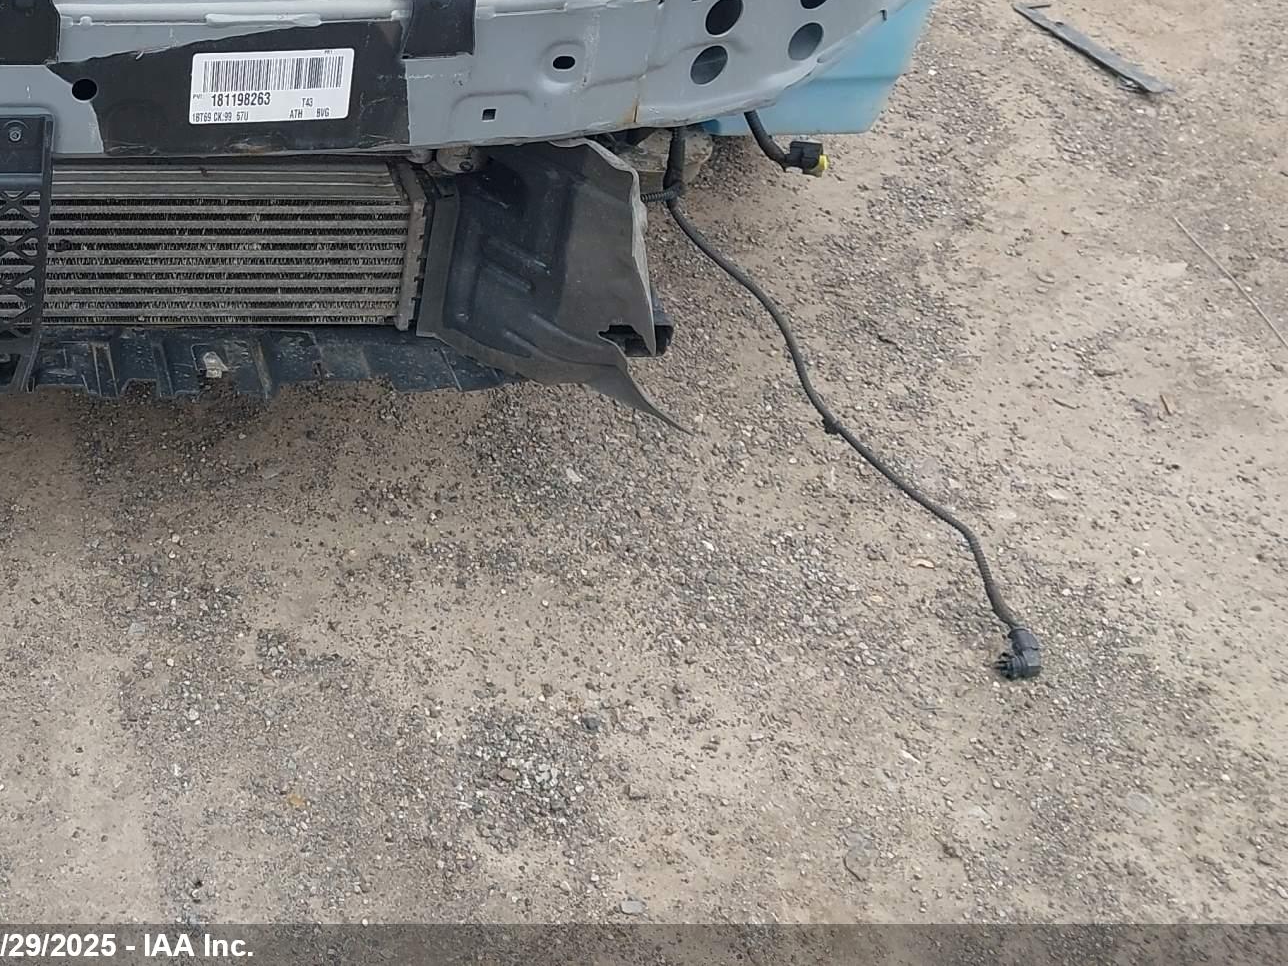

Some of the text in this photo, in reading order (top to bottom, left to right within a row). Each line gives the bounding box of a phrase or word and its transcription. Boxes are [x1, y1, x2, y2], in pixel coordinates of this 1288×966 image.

[211, 91, 271, 107] 181198263
[302, 97, 314, 107] T43
[289, 108, 303, 119] ATH
[316, 107, 330, 118] BVG
